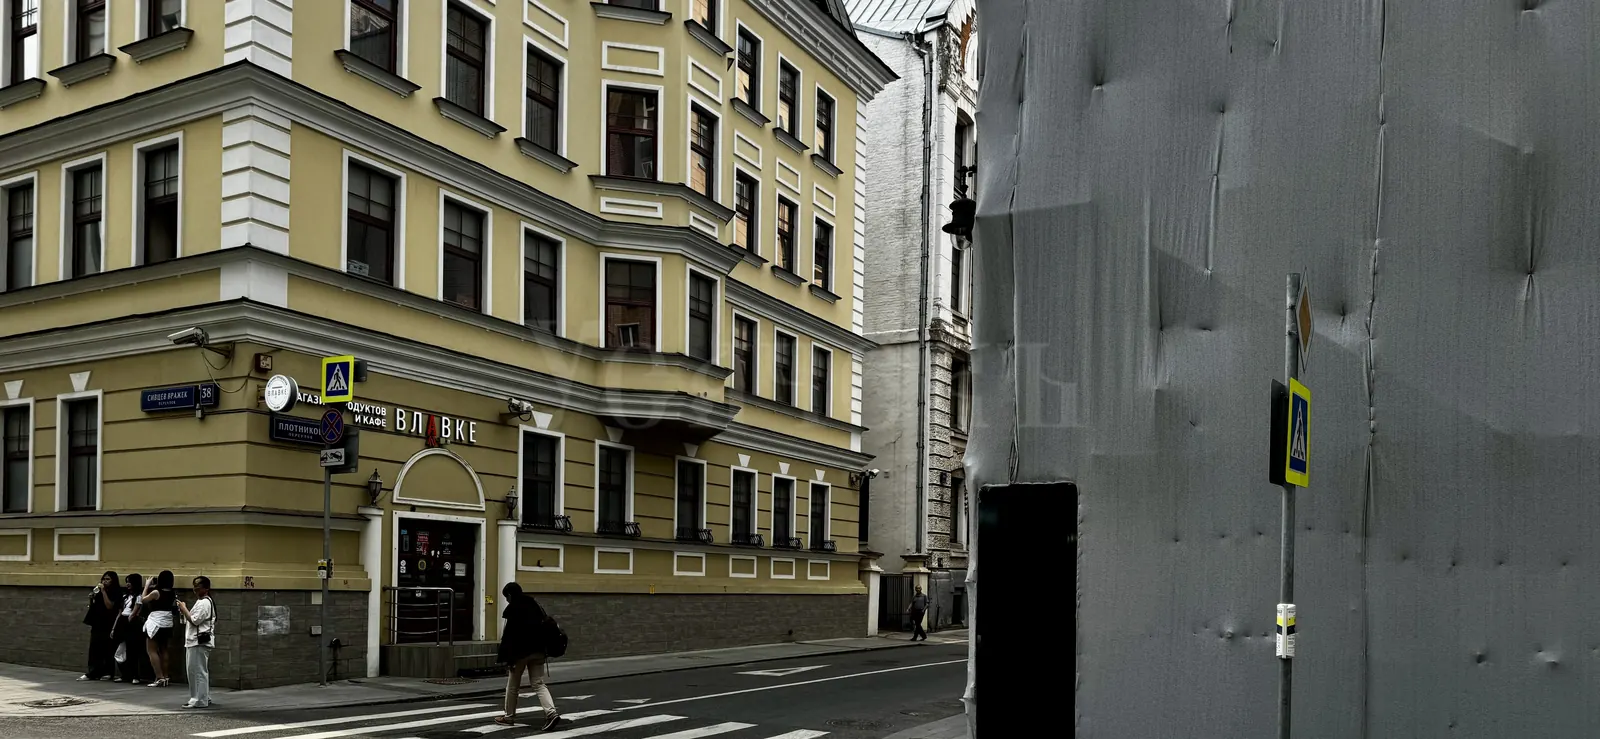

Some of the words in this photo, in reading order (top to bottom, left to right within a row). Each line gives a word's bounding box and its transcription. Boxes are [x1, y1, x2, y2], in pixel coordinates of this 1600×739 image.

[147, 392, 167, 402] СИВЦЕВ
[167, 390, 188, 400] ВРАЖЕК
[201, 387, 212, 399] 38
[297, 392, 326, 406] АГАЗИ
[345, 400, 388, 417] ОДУКТОВ
[355, 414, 362, 423] И
[363, 415, 387, 428] КАФЕ
[396, 408, 477, 446] ВЛАВКЕ
